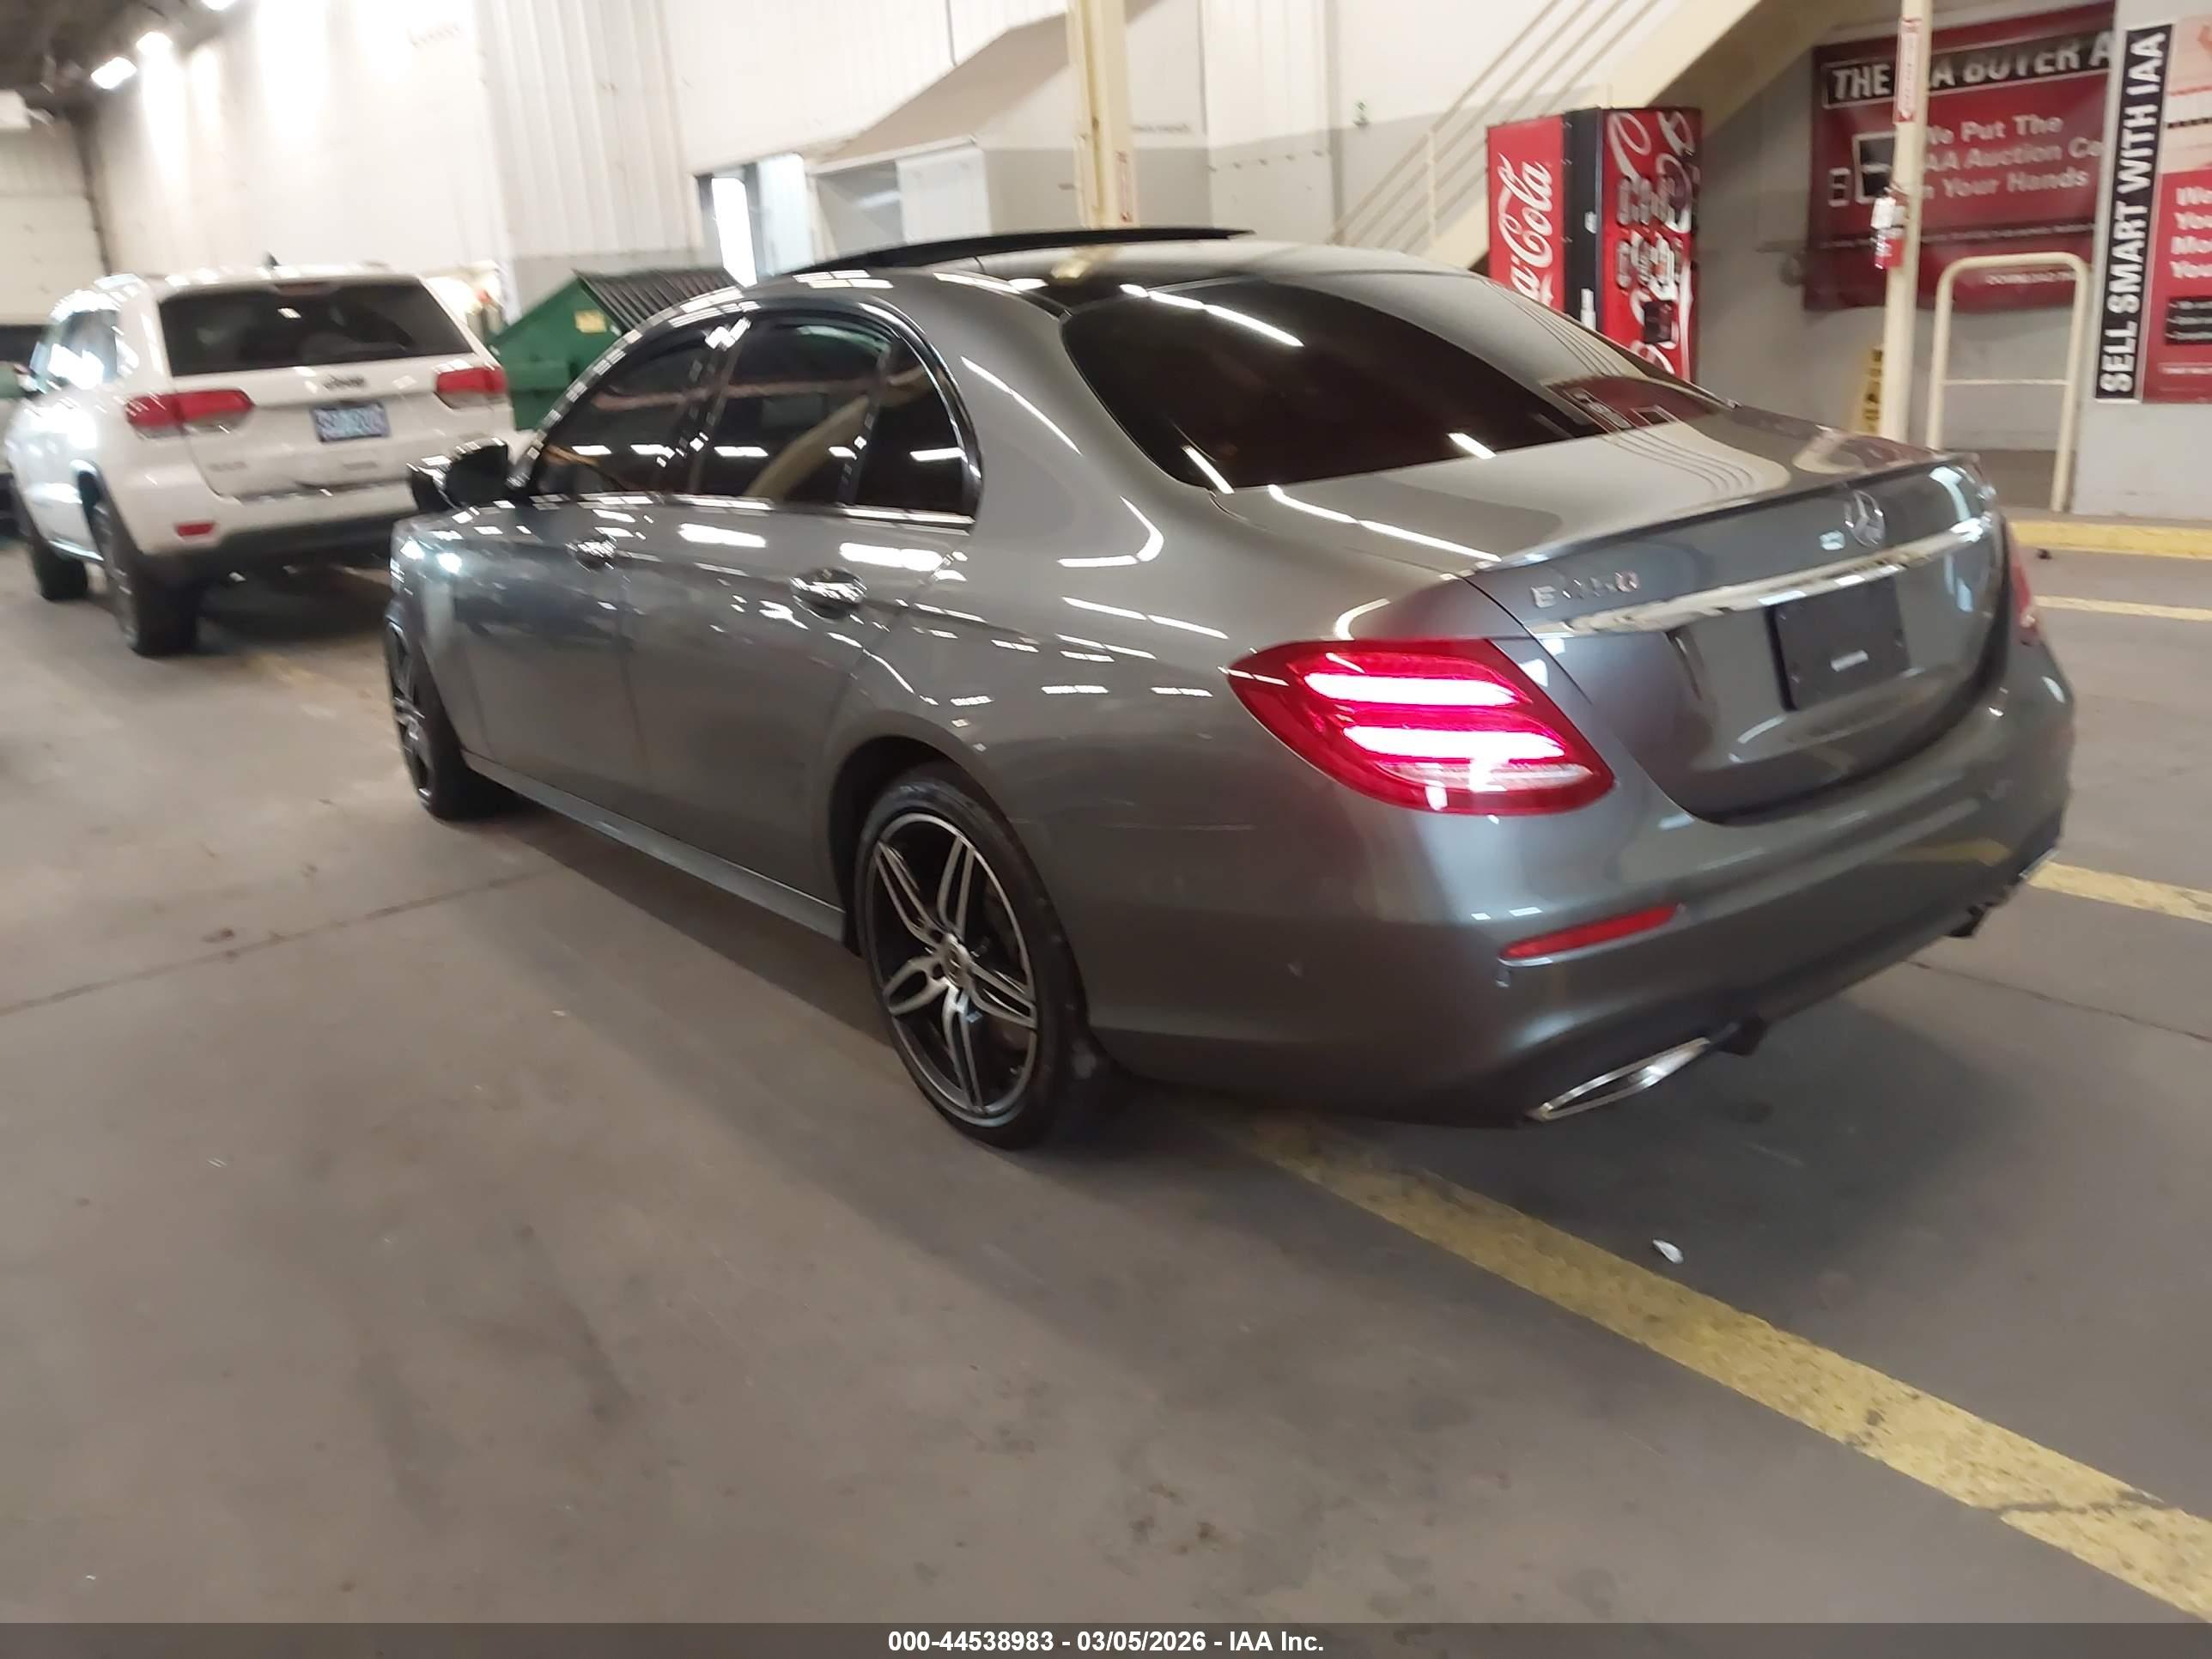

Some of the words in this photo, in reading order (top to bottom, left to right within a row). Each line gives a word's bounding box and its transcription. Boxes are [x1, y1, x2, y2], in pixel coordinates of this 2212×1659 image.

[1832, 63, 1891, 101] THE
[2127, 32, 2166, 95] IAA
[1960, 120, 2006, 143] Put
[2012, 114, 2063, 136] The
[2117, 104, 2158, 194] WITH
[1963, 143, 2063, 169] Auction
[1942, 177, 2000, 198] Your
[2006, 166, 2089, 192] Hands
[2106, 201, 2147, 316] SMART
[2100, 319, 2137, 392] SELL
